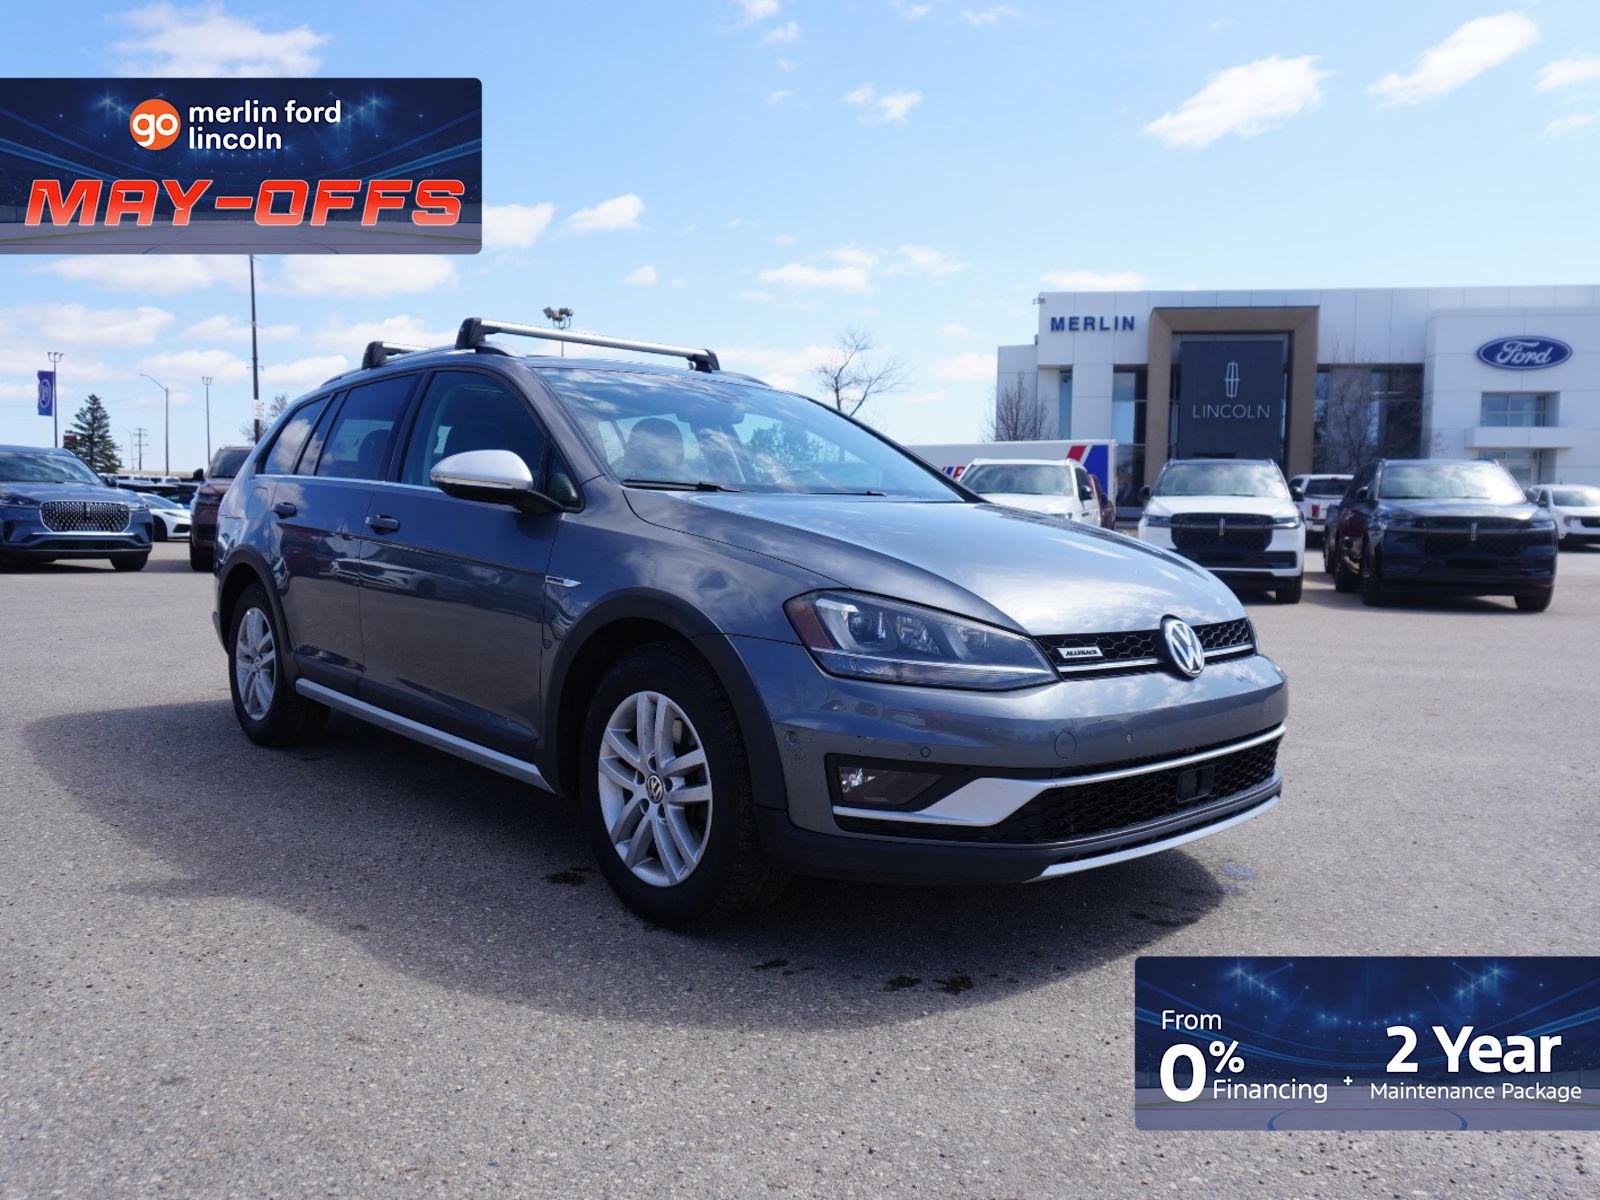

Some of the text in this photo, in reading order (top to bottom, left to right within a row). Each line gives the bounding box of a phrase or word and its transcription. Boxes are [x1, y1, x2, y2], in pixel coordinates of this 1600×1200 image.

[1050, 316, 1135, 331] MERLIN
[1496, 340, 1554, 364] Ford
[1192, 404, 1270, 419] LINCOLN
